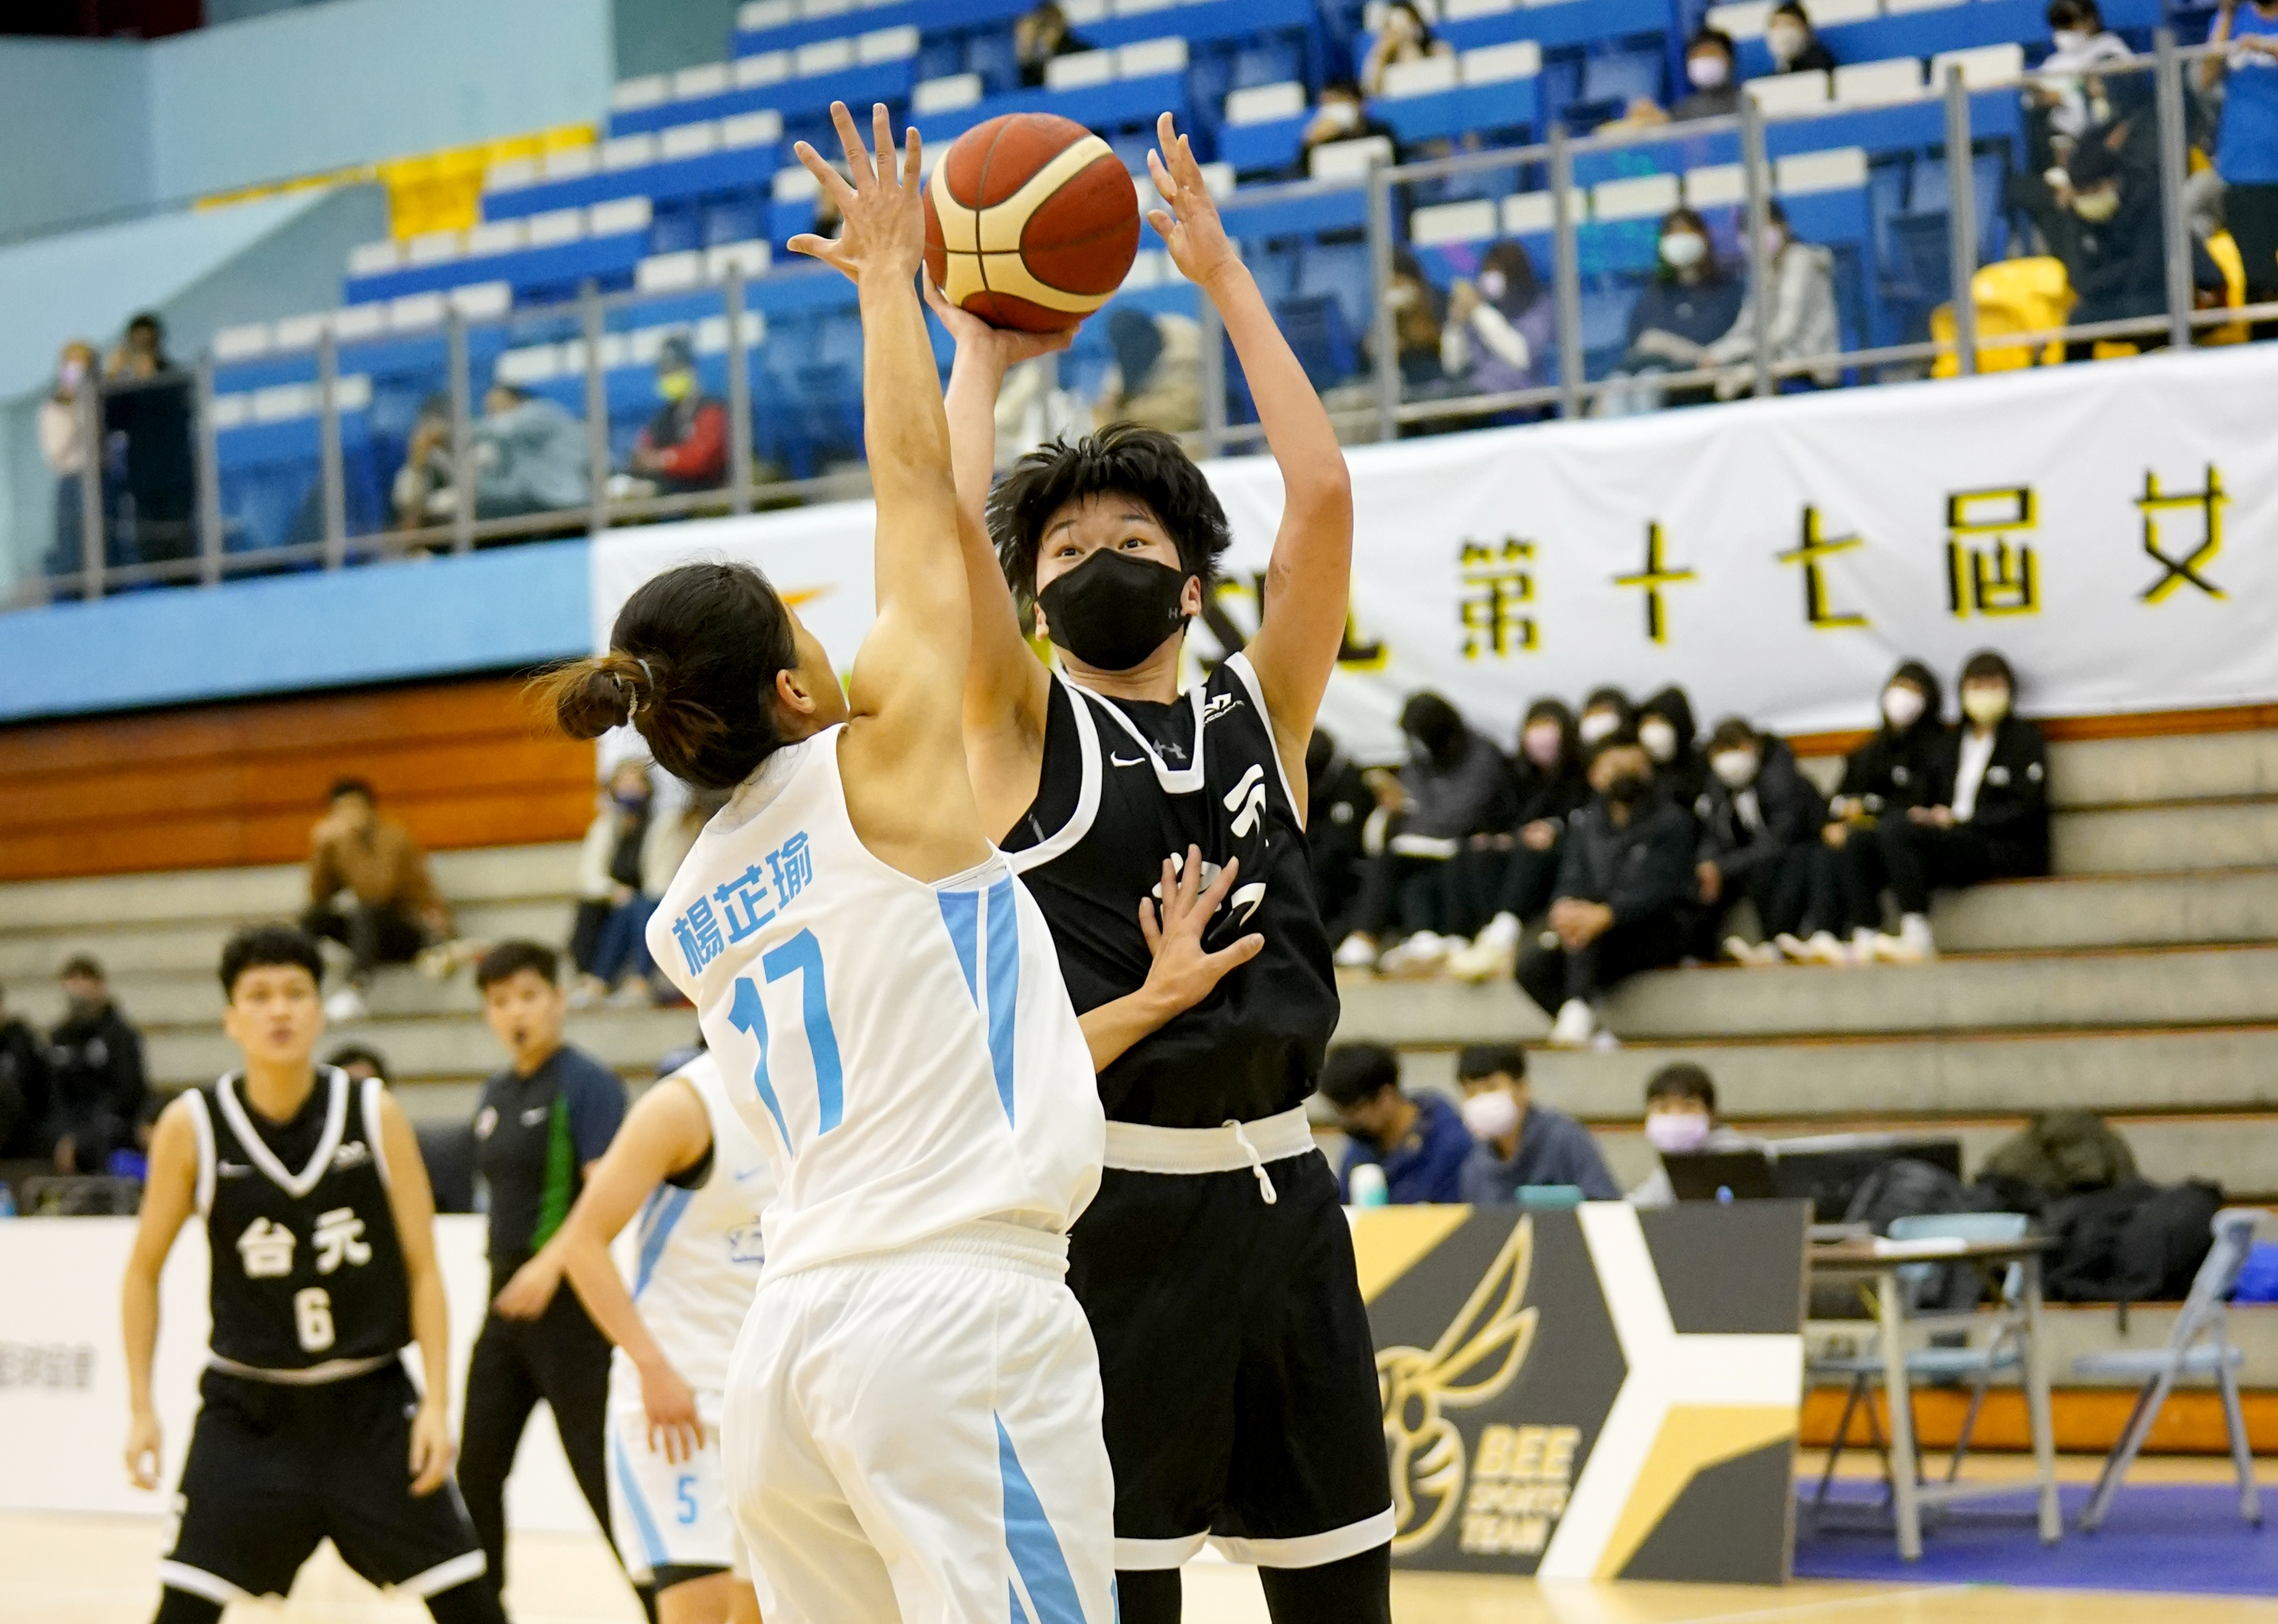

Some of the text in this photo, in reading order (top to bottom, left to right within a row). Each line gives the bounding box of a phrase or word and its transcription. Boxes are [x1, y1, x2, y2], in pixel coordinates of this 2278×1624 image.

[1459, 462, 2229, 658] 第十七屆女
[672, 830, 814, 977] 楊芷瑜
[727, 926, 843, 1161] 17
[236, 1206, 373, 1278] 台元
[294, 1286, 335, 1352] 6
[1472, 1424, 1582, 1479] BEE
[677, 1474, 699, 1524] 5
